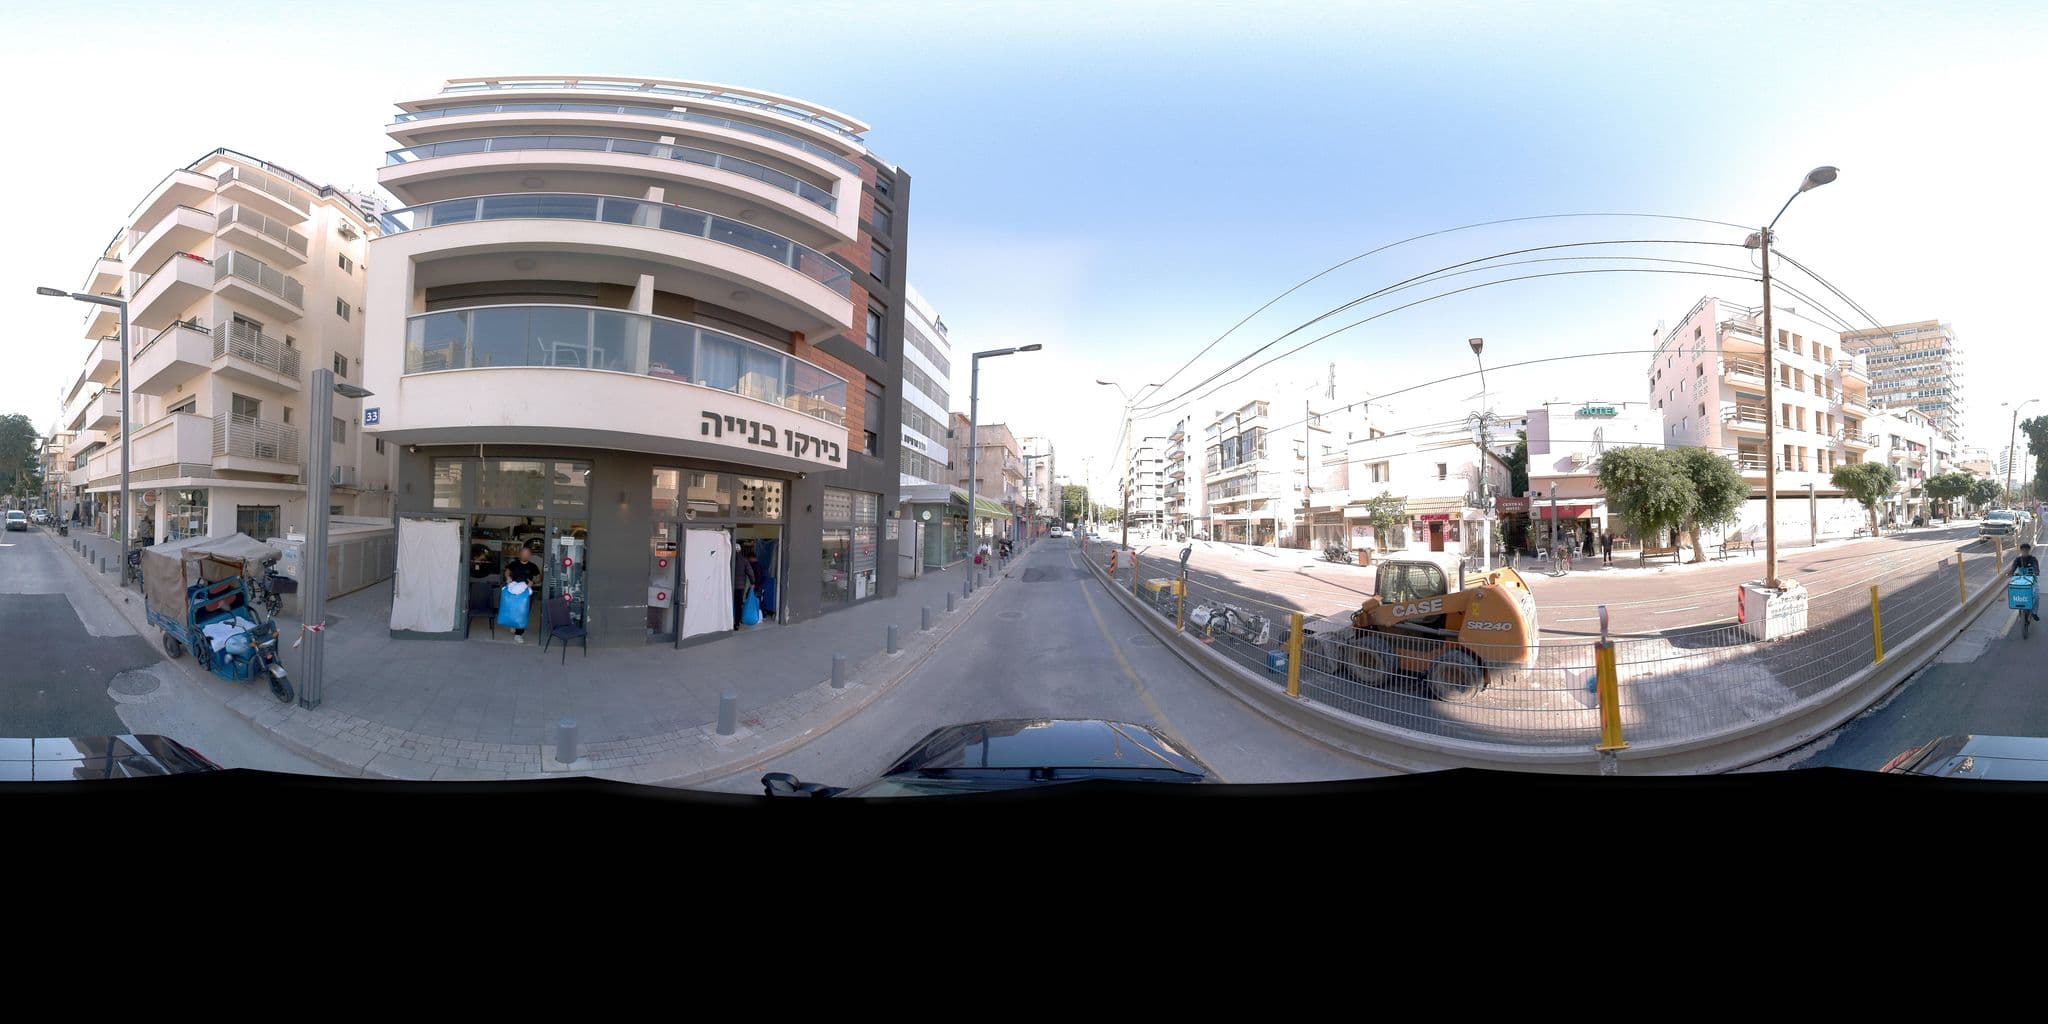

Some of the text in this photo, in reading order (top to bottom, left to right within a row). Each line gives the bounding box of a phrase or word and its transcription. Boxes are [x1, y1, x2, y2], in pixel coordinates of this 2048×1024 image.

[367, 411, 377, 421] 33
[1580, 406, 1618, 416] HOTEL
[701, 410, 841, 463] בירקו בנייה
[1392, 599, 1443, 617] CASE
[1467, 621, 1512, 631] SR240
